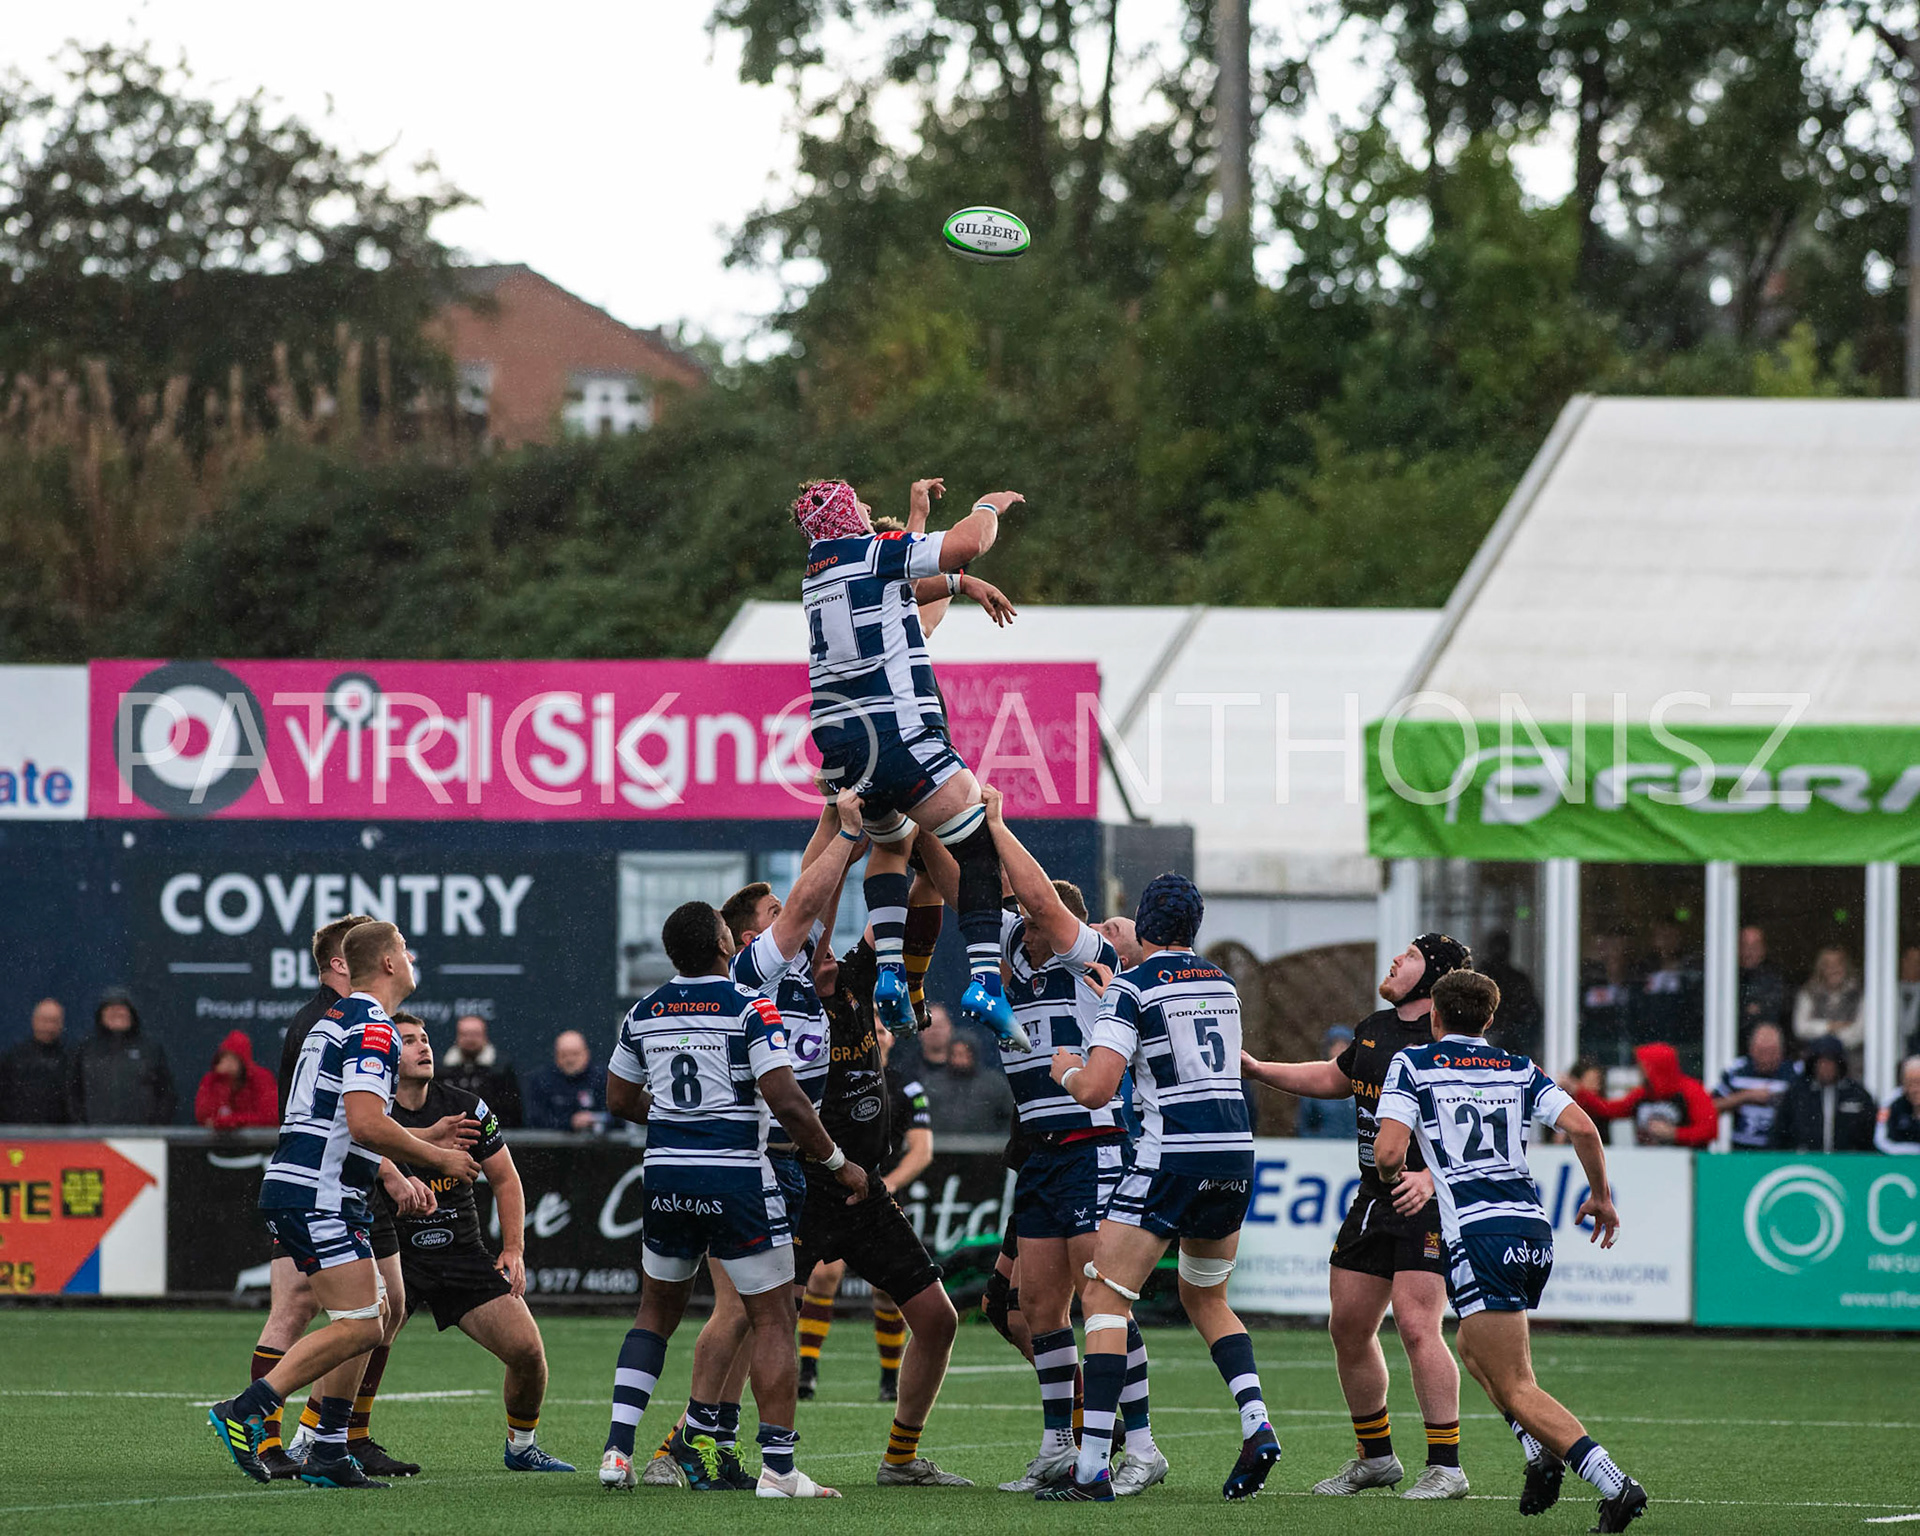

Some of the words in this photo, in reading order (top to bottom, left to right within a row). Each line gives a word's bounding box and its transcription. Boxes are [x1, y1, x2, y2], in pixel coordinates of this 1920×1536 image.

[955, 222, 1021, 241] GILBERT
[810, 608, 829, 662] 4
[529, 693, 811, 808] Signz
[160, 872, 534, 936] COVENTRY
[1175, 967, 1223, 980] zenzero
[667, 1002, 720, 1013] zenzero
[831, 1031, 876, 1062] GRANGE
[1193, 1018, 1226, 1073] 5
[1454, 1057, 1511, 1068] zenzero
[671, 1053, 702, 1109] 8
[842, 1078, 883, 1099] JAGUAR
[1352, 1079, 1382, 1100] GRAN
[1455, 1103, 1509, 1162] 21
[430, 1176, 460, 1194] NGE
[651, 1193, 723, 1215] askews
